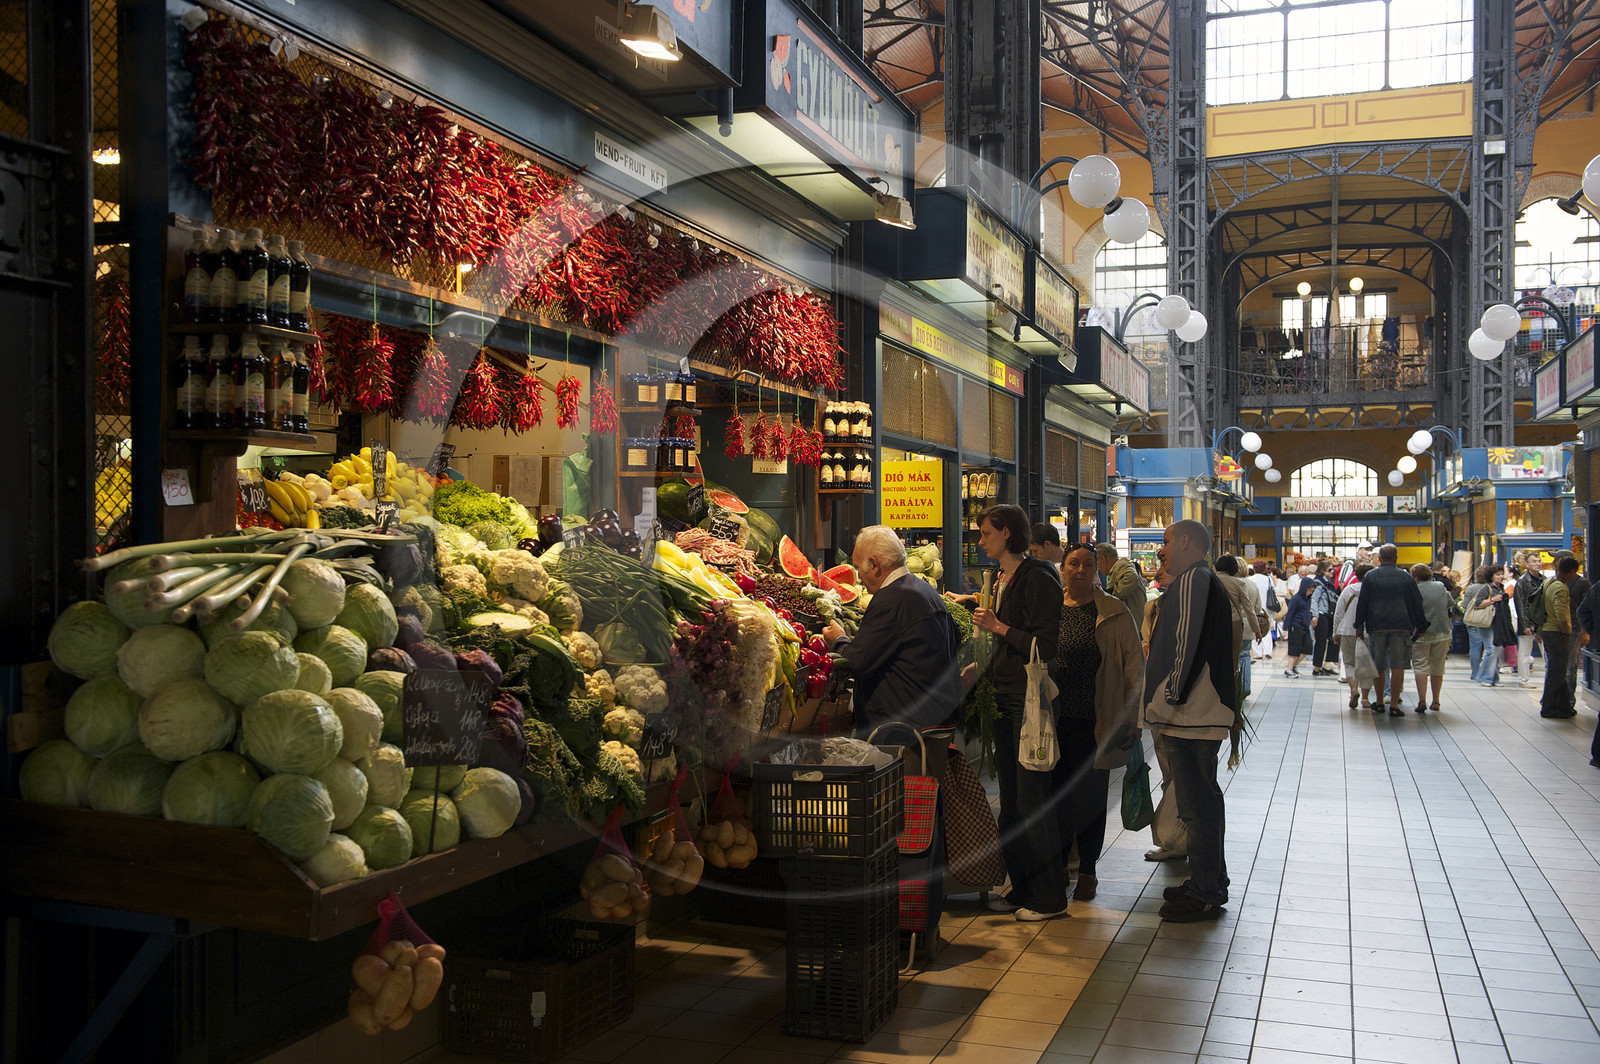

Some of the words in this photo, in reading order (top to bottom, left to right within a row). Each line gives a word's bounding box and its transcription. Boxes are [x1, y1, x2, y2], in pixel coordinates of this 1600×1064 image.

[595, 139, 647, 177] MEND-FRUIT
[650, 168, 666, 187] KFT
[915, 325, 926, 345] BIÓ
[926, 327, 932, 348] ÉS
[885, 470, 904, 482] DIÓ
[908, 470, 932, 482] MÁK
[163, 482, 189, 499] 150
[885, 496, 934, 507] DARÁLVA
[889, 512, 929, 520] KAPHATÓ!
